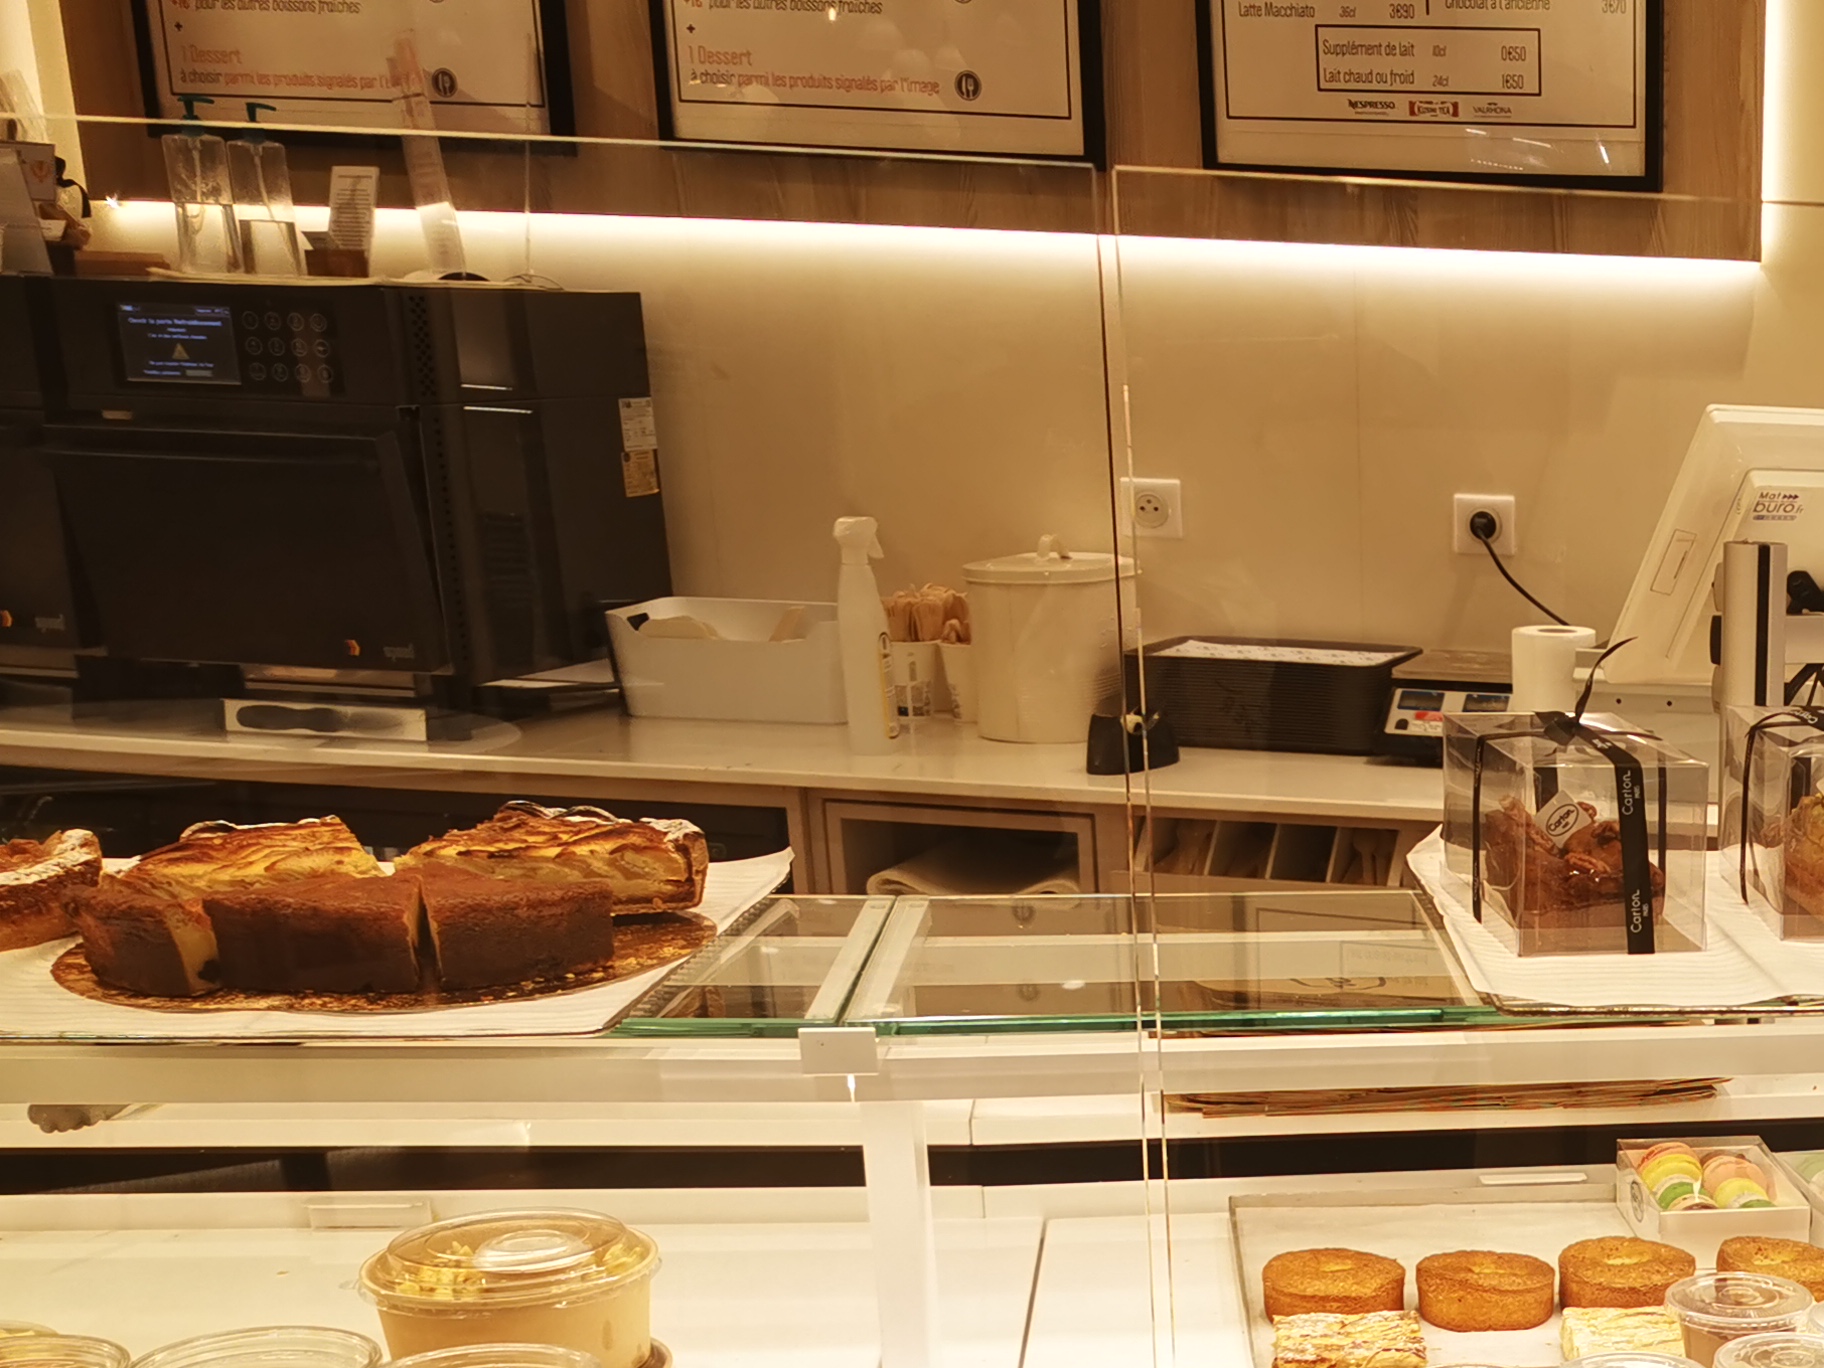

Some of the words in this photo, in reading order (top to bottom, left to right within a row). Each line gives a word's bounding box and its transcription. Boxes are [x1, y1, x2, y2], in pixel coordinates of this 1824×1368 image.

[1238, 1, 1263, 18] Latte
[1264, 1, 1316, 18] Macchiato
[189, 44, 243, 64] Dessert
[698, 45, 753, 66] Dessert
[1322, 39, 1383, 58] Supplément
[1384, 41, 1397, 57] de
[1399, 42, 1415, 57] lait
[1500, 46, 1527, 62] 0€50
[187, 68, 223, 84] choisir
[700, 68, 736, 85] choisir
[737, 71, 770, 88] parmi
[771, 71, 787, 88] les
[788, 72, 833, 90] produits
[834, 74, 879, 93] signalés
[879, 78, 899, 94] par
[1323, 67, 1342, 84] Lait
[1343, 68, 1373, 84] chaud
[1375, 71, 1388, 84] ou
[1389, 69, 1415, 87] froid
[1501, 73, 1524, 90] 1€50
[1758, 491, 1782, 500] Mat
[1621, 769, 1634, 816] Carton
[1547, 808, 1576, 832] Carton
[1630, 888, 1642, 933] Carton
